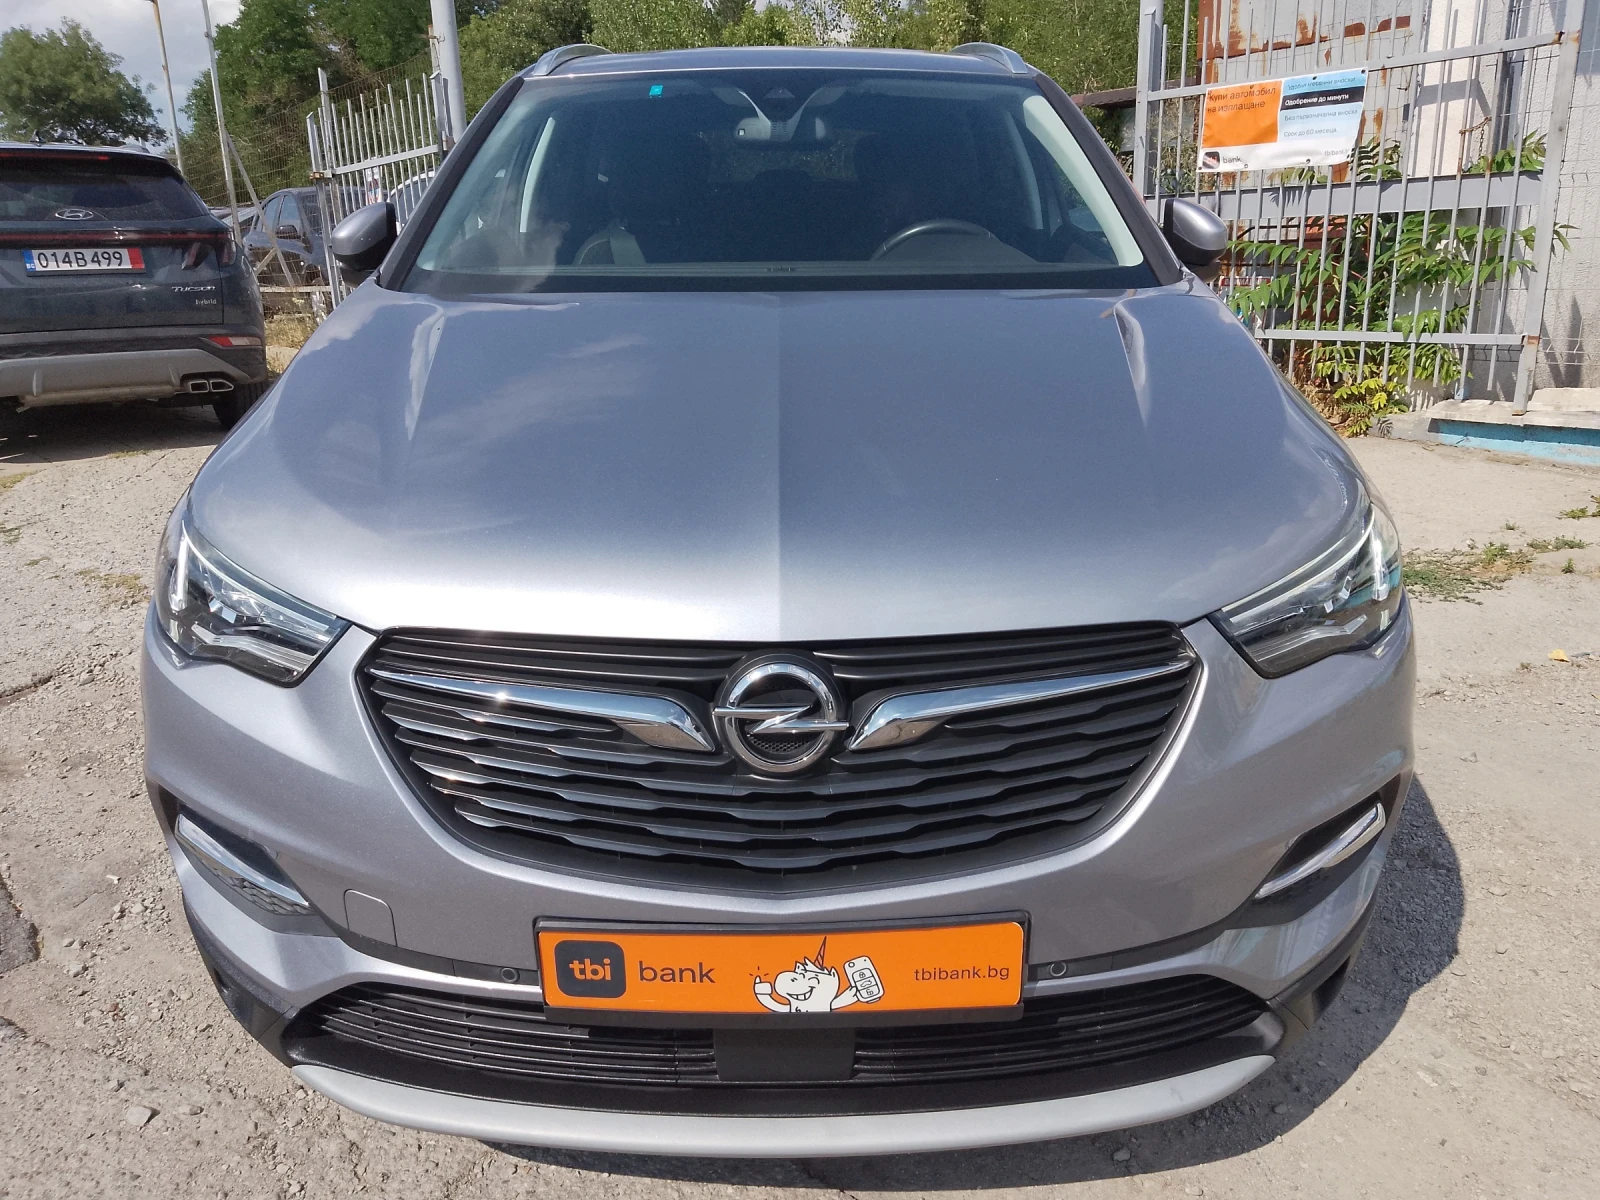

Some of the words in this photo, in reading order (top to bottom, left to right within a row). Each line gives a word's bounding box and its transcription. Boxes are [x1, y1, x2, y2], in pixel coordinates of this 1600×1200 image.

[1209, 93, 1228, 103] Купи
[1230, 87, 1276, 99] автомобил
[1218, 100, 1266, 112] изплащане
[1285, 97, 1318, 106] Одобрение
[1222, 156, 1242, 164] bank
[195, 298, 217, 306] hybrid
[569, 958, 612, 981] tbi
[638, 960, 716, 984] bank
[913, 965, 1010, 981] tbibank.bg
